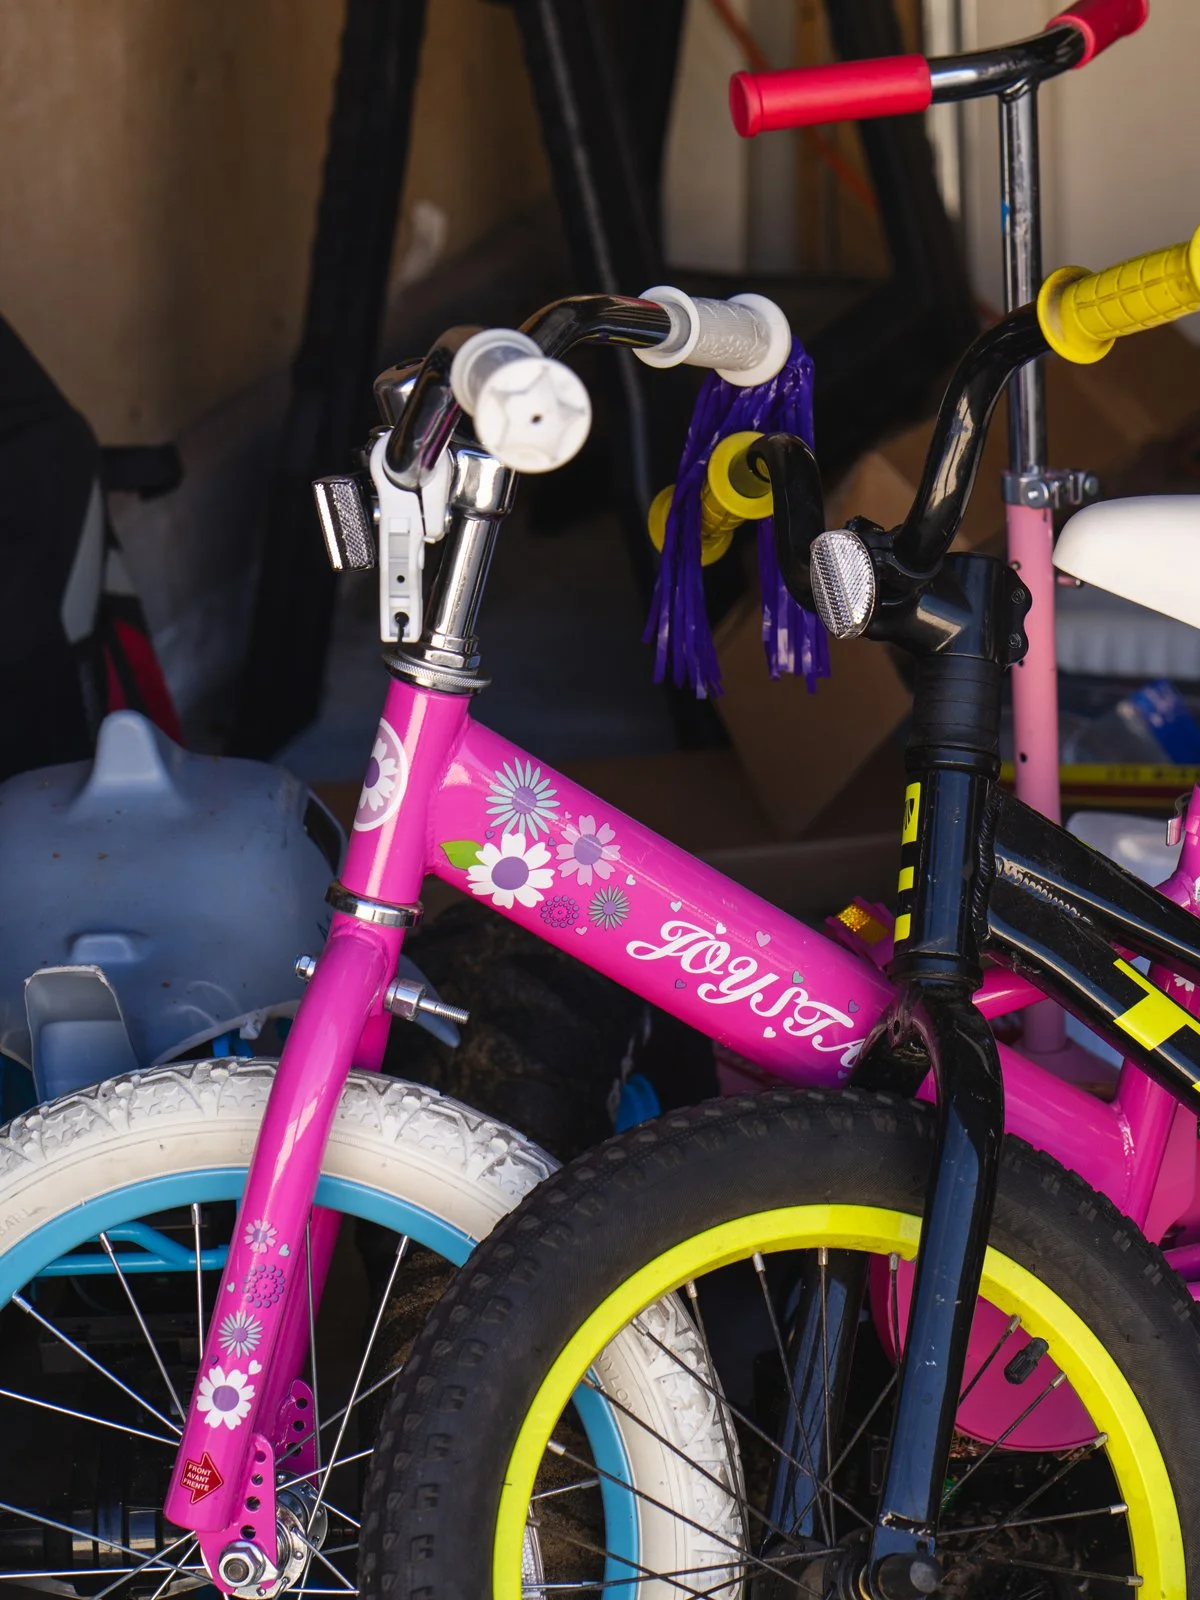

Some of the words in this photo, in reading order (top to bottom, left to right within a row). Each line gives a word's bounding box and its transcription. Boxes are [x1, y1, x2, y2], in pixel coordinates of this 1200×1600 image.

[188, 1464, 211, 1476] FRONT
[186, 1472, 209, 1484] AVANT
[183, 1478, 209, 1491] FRENTE
